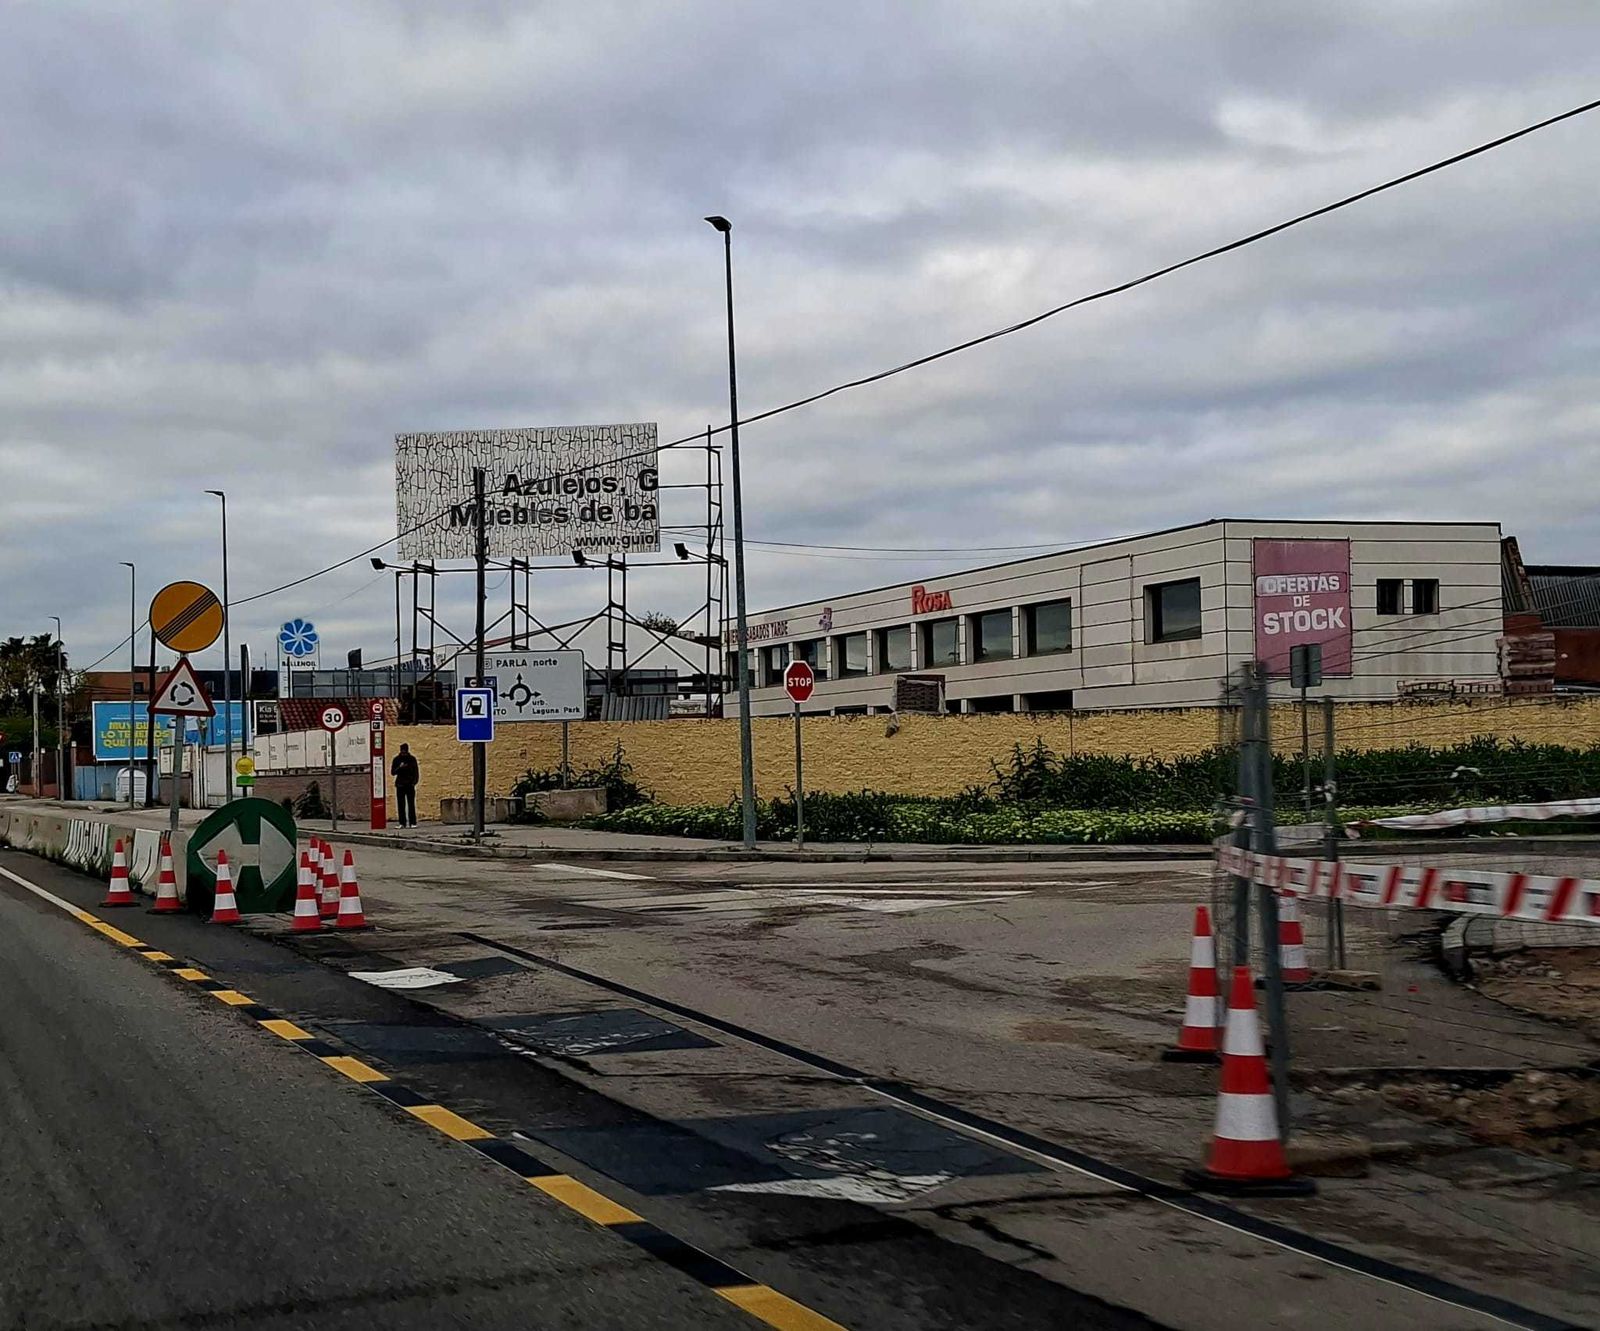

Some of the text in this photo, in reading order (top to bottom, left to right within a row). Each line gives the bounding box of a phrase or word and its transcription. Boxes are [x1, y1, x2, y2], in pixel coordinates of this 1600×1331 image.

[580, 499, 614, 522] de
[624, 498, 657, 521] ba
[1264, 575, 1340, 594] OFERTAS
[1293, 595, 1311, 607] DE
[1263, 606, 1347, 635] STOCK
[496, 658, 558, 668] PARLA norte
[788, 677, 812, 687] STOP
[532, 707, 560, 715] Laguna
[324, 712, 342, 723] 30
